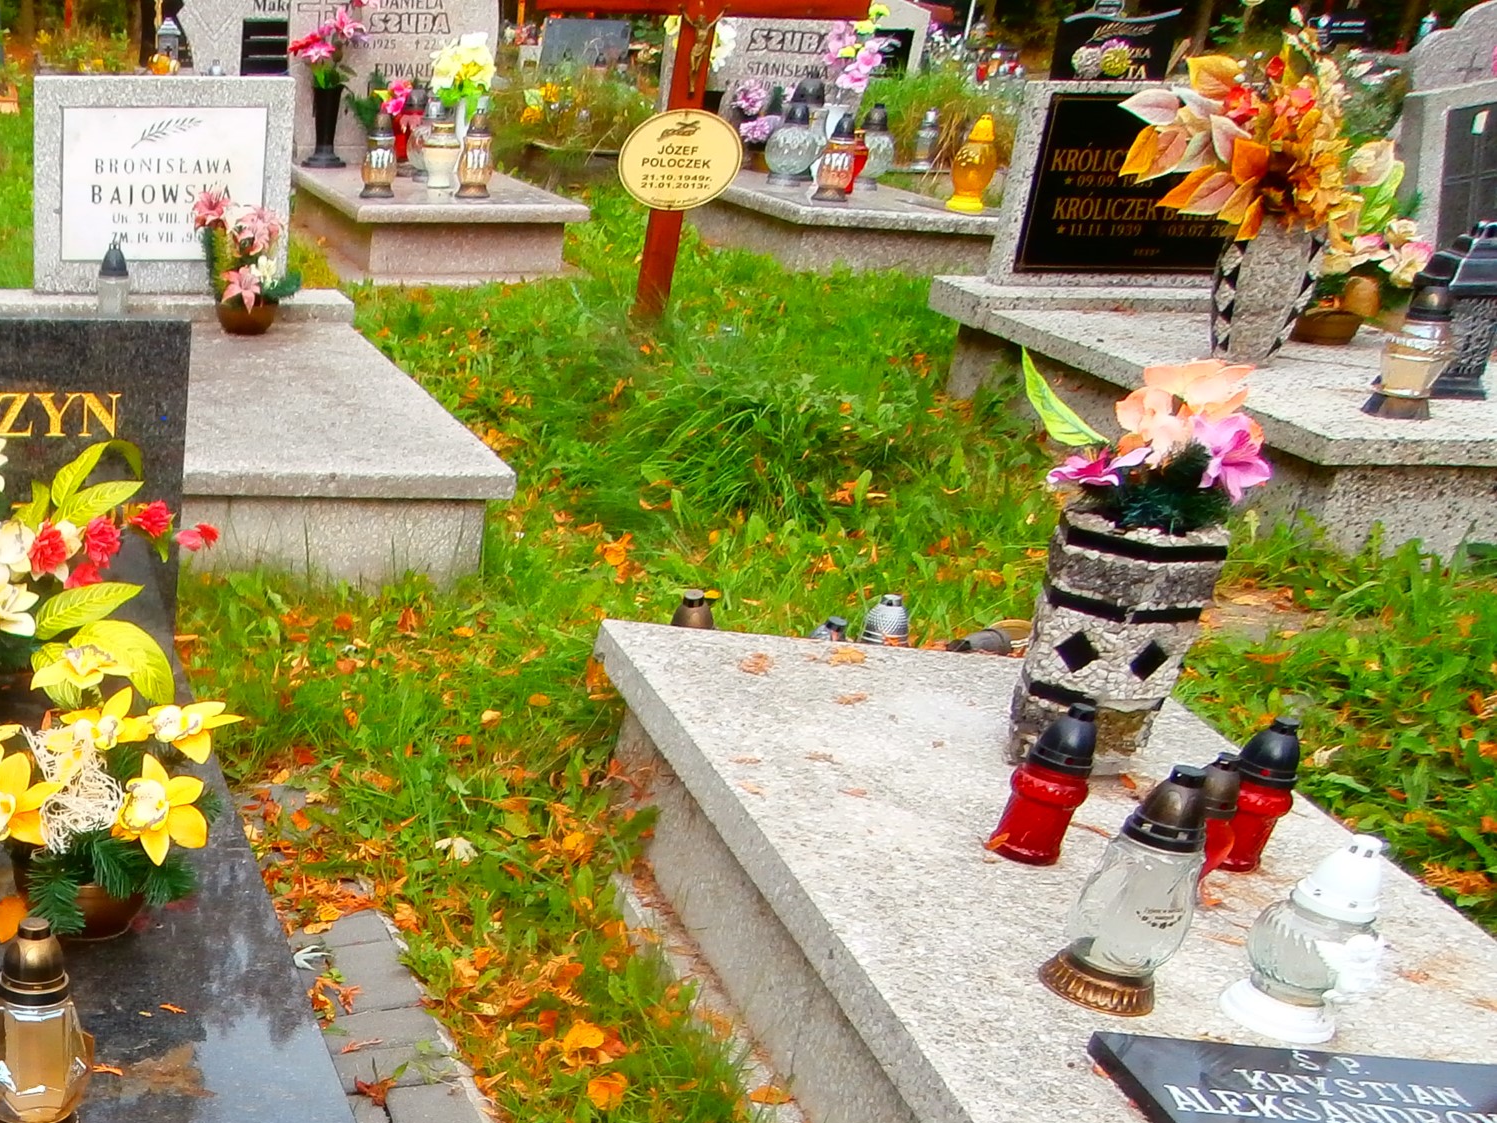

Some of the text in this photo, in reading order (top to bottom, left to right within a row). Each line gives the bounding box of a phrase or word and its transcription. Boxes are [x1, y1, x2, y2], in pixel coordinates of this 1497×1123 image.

[369, 12, 451, 34] SZUBA
[657, 143, 699, 156] JÓZEF
[95, 157, 232, 175] BRONISŁAWA
[641, 157, 711, 169] POLOCZEK
[642, 174, 713, 182] 21.10.1949r.
[640, 182, 710, 190] 21.01.2013r.
[1233, 1068, 1472, 1107] KRYSTIAN
